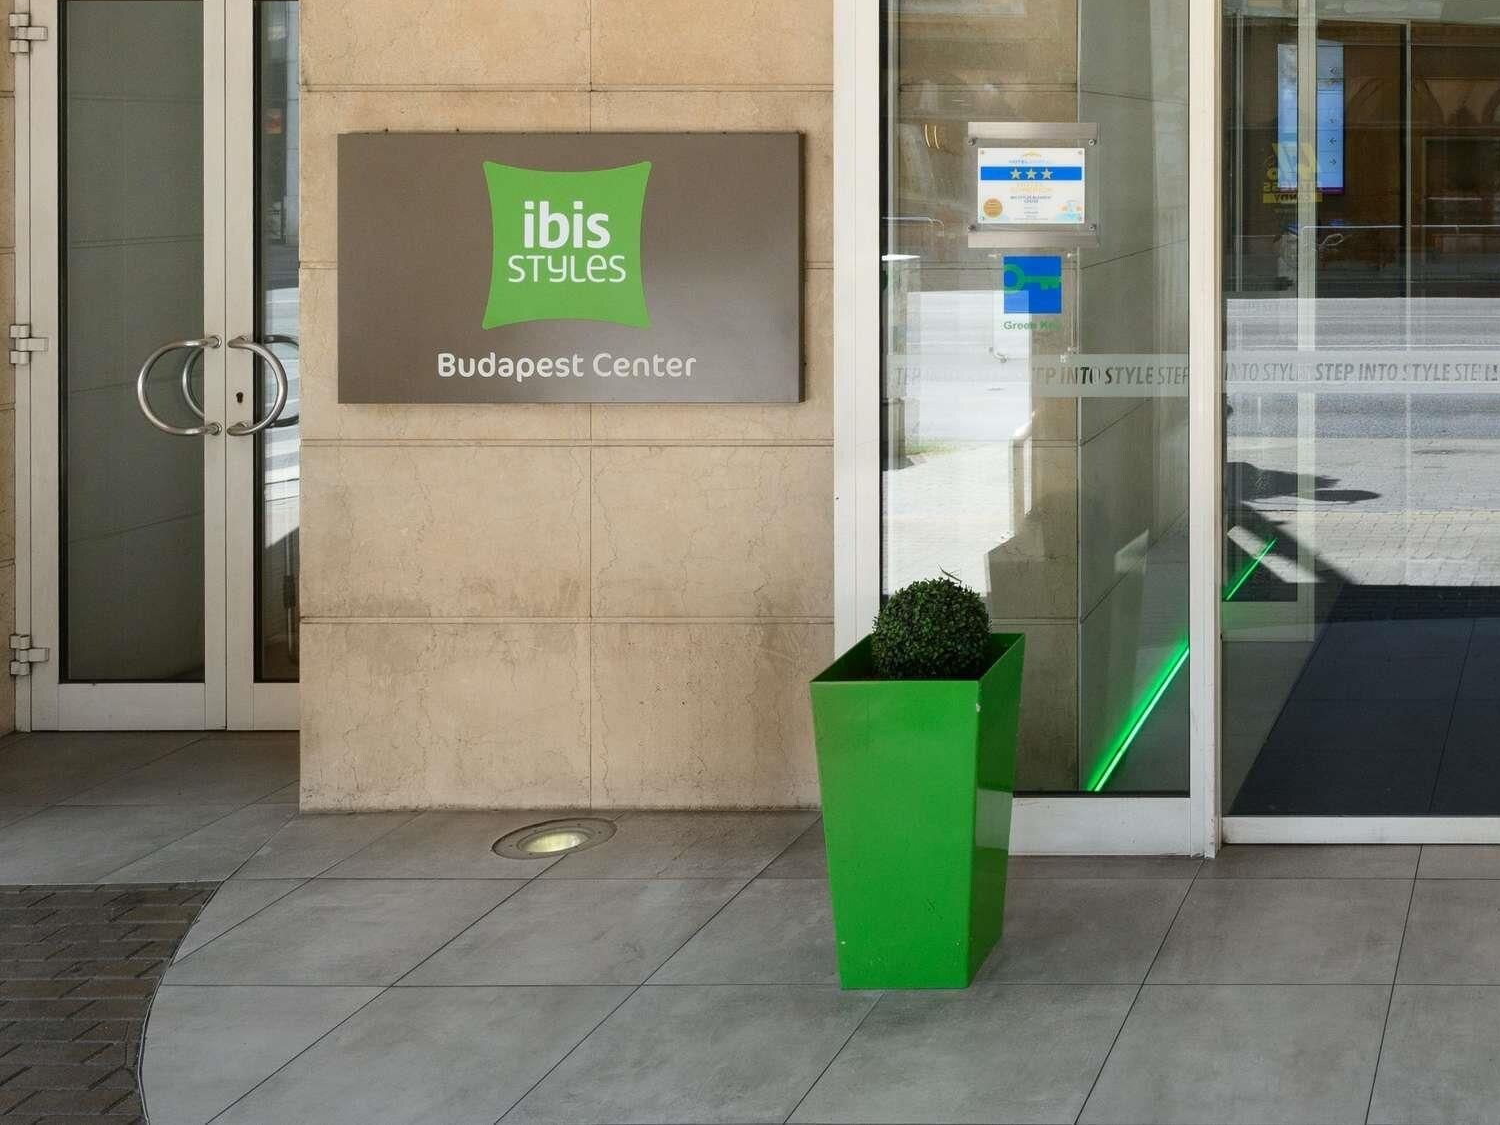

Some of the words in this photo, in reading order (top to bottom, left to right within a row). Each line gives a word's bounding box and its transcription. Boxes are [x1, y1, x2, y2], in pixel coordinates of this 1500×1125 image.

[524, 200, 611, 249] ibis
[437, 352, 584, 383] Budapest
[592, 353, 697, 377] Center
[1103, 365, 1154, 386] STYLE
[1314, 363, 1355, 382] STEP
[1358, 363, 1398, 382] INTO
[1402, 363, 1451, 382] STYLE
